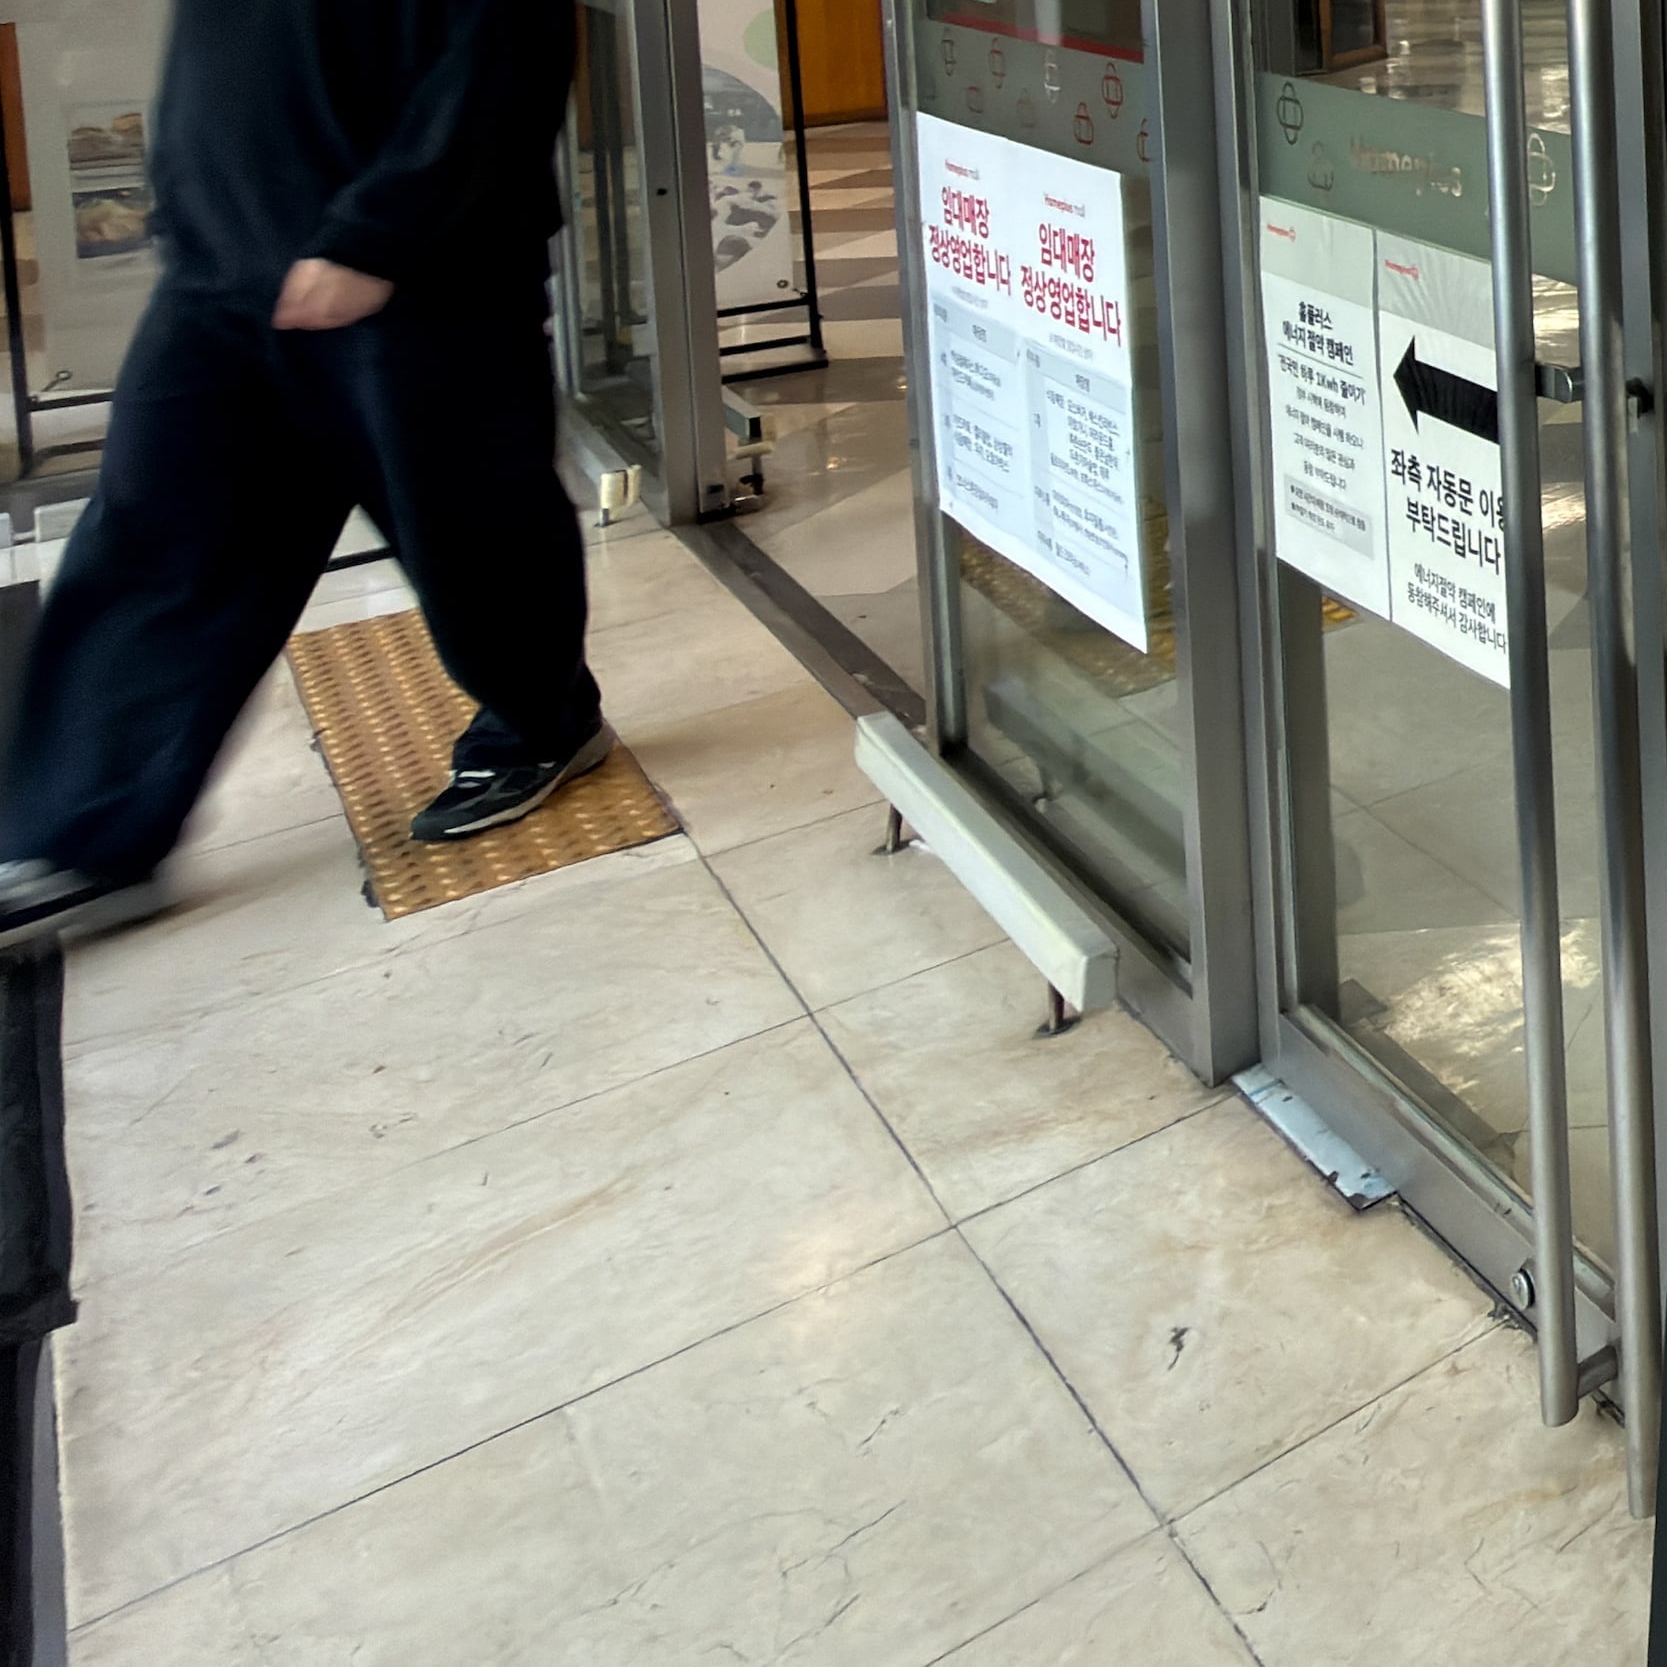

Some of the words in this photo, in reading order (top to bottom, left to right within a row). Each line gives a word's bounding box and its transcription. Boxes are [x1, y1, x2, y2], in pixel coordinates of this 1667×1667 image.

[941, 186, 990, 239] 임대매장
[929, 225, 1012, 296] 정상영업합니다
[1038, 223, 1095, 283] 임대매장
[1021, 265, 1122, 348] 정상영업합니다
[1326, 338, 1354, 367] 캠페인
[1390, 448, 1423, 493] 좌측
[1426, 464, 1474, 517] 자동문
[1406, 496, 1501, 576] 부탁드립니다
[1458, 612, 1507, 654] 감사합니다
